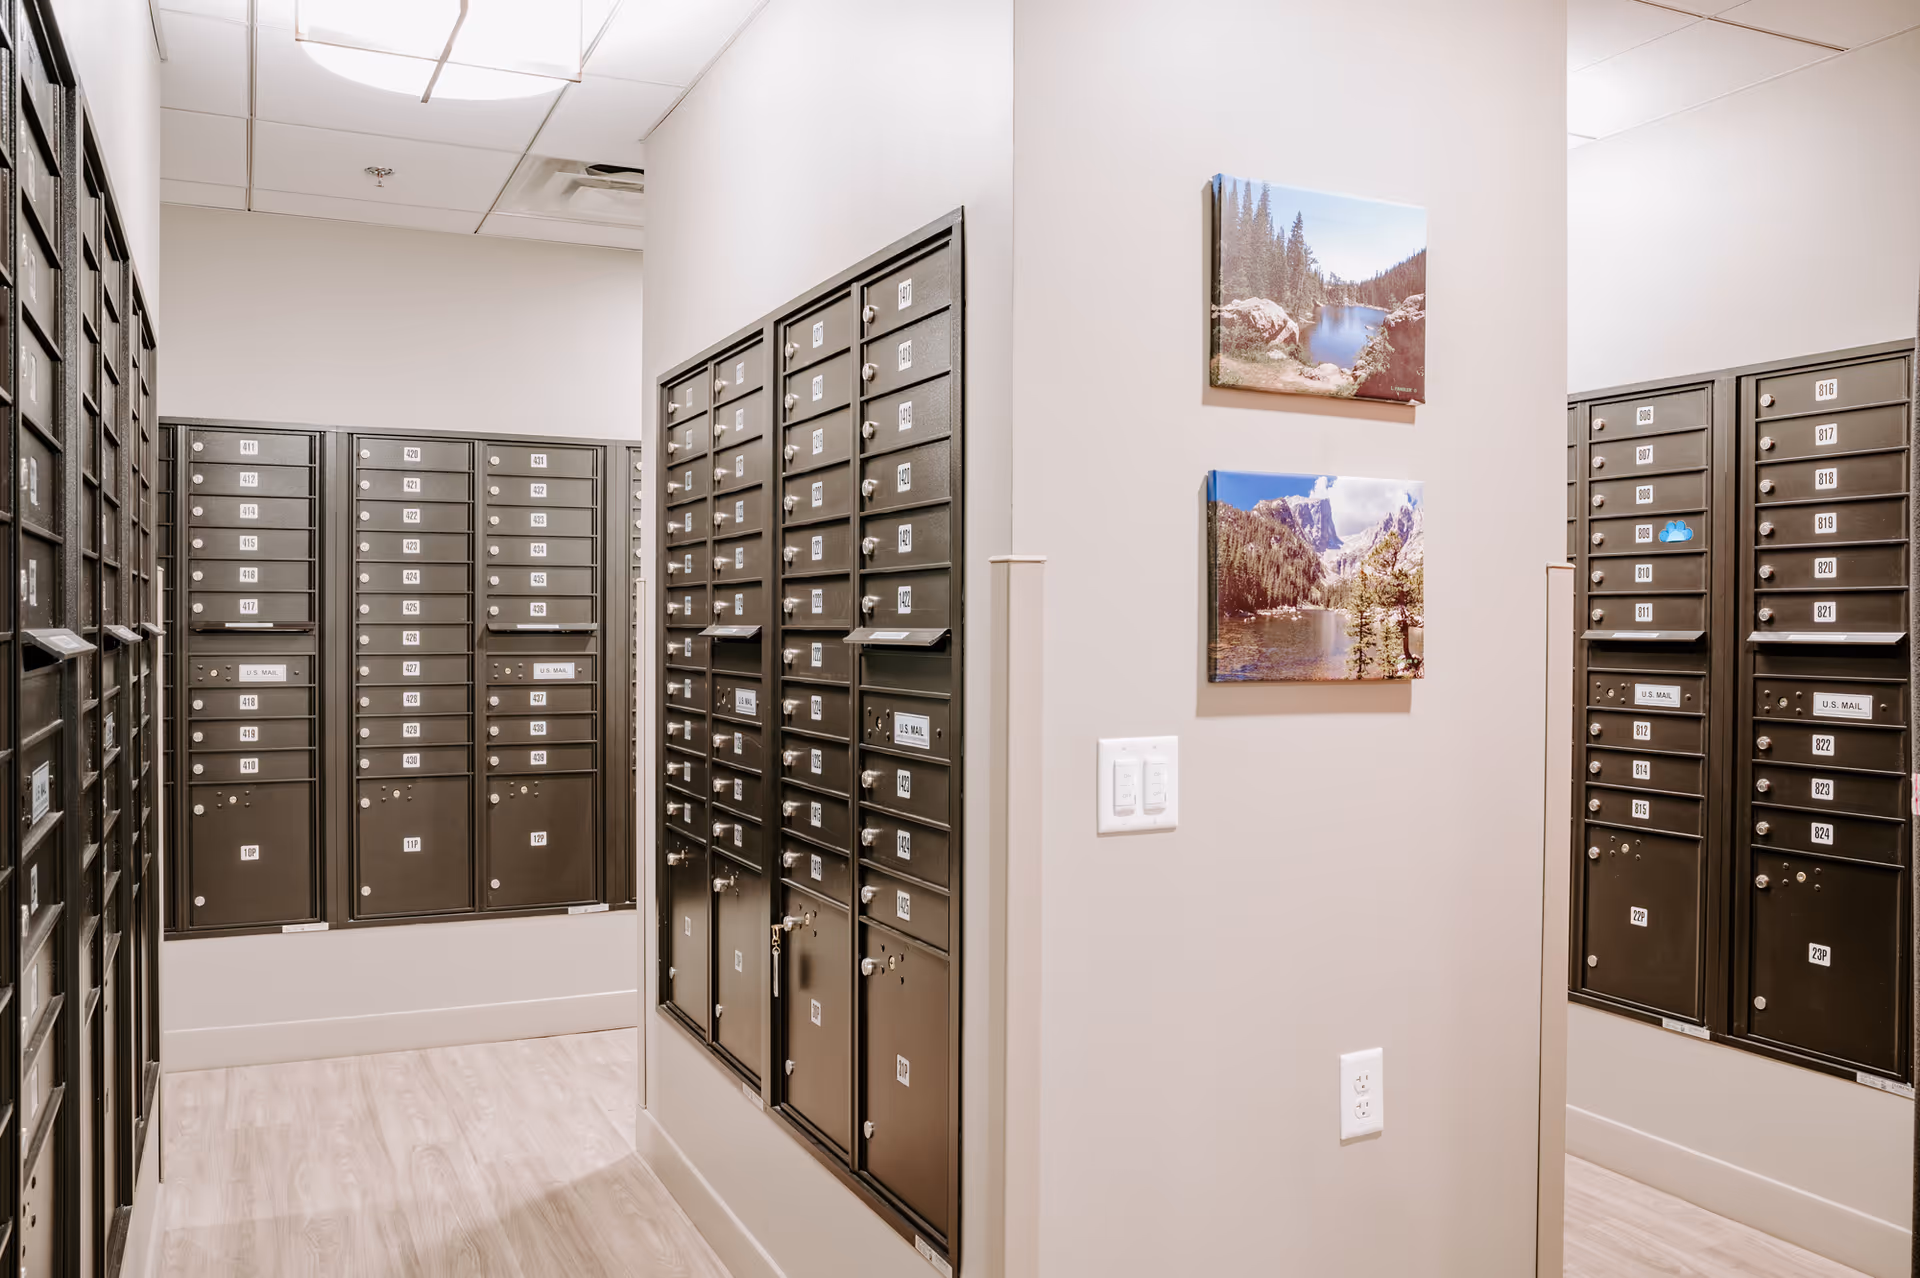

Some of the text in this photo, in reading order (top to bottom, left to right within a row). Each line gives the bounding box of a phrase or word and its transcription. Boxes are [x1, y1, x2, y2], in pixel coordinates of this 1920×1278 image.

[1818, 382, 1835, 397] 816
[1638, 408, 1652, 422] 806
[1818, 426, 1834, 442] 817
[242, 441, 255, 452] 411
[405, 448, 419, 459] 420
[1638, 447, 1651, 461] 807
[532, 455, 544, 466] 431
[242, 474, 256, 484] 412
[1818, 471, 1834, 486] 818
[405, 479, 418, 490] 421
[532, 485, 545, 495] 432
[1638, 487, 1651, 501] 808
[242, 506, 256, 516] 414
[405, 510, 418, 521] 422
[1817, 515, 1834, 530] 819
[899, 528, 911, 547] 1421
[1637, 527, 1650, 540] 809
[242, 537, 256, 548] 415
[405, 540, 418, 551] 423
[1637, 566, 1650, 579] 810
[1817, 560, 1834, 574] 820
[242, 569, 256, 580] 416
[405, 571, 418, 582] 424
[532, 574, 545, 584] 435
[899, 590, 910, 609] 1422
[242, 601, 256, 611] 417
[404, 602, 418, 613] 425
[1817, 604, 1832, 619] 821
[1637, 606, 1650, 618] 811
[405, 663, 418, 673] 427
[405, 693, 418, 704] 428
[532, 693, 544, 703] 437
[1641, 690, 1672, 700] U.S. MAIL
[242, 696, 256, 707] 418
[1822, 700, 1863, 711] U.S. MAIL
[242, 728, 256, 739] 419
[405, 724, 418, 735] 429
[910, 724, 924, 737] MAIL
[1635, 724, 1649, 737] 812
[1815, 737, 1831, 752] 822
[405, 755, 418, 765] 430
[1635, 763, 1648, 776] 814
[898, 774, 909, 794] 1423
[1814, 781, 1830, 796] 823
[1634, 802, 1647, 816] 815
[533, 833, 545, 843] 12P
[1814, 826, 1830, 840] 824
[406, 839, 419, 849] 11P
[898, 834, 909, 854] 1424
[243, 847, 257, 858] 10P
[898, 895, 909, 916] 1425
[1633, 909, 1646, 923] 22P
[1811, 946, 1828, 962] 23P
